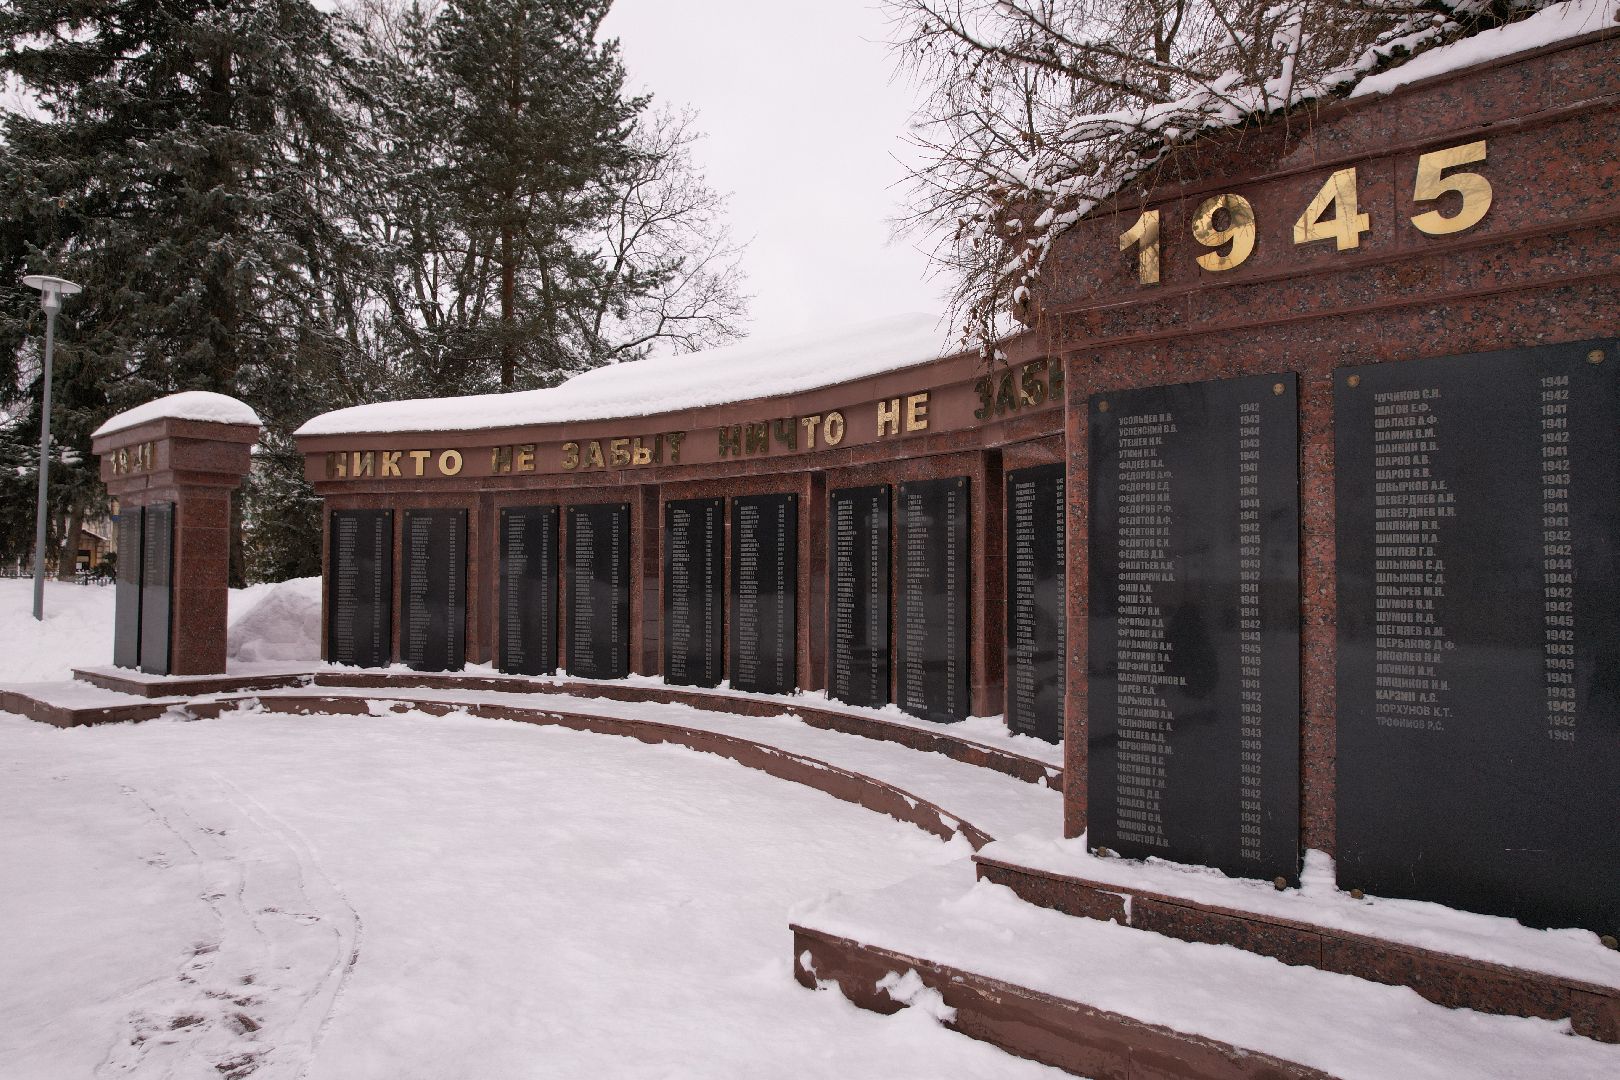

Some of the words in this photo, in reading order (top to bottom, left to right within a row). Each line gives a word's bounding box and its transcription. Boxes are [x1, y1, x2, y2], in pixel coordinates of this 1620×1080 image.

[1119, 140, 1493, 284] 1945
[1540, 376, 1568, 387] 1944
[1541, 390, 1568, 401] 1942
[1375, 405, 1408, 415] ШАГОВ
[1541, 404, 1567, 415] 1941
[1375, 417, 1415, 428] ШАЛАЕВ
[1541, 418, 1567, 429] 1941
[325, 449, 463, 478] НИКТО
[491, 444, 536, 473] НЕ
[561, 433, 686, 470] ЗАБЫТ
[718, 411, 844, 457] НИЧТО
[877, 393, 928, 437] НЕ
[1542, 432, 1569, 443] 1942
[1542, 446, 1568, 457] 1941
[1376, 456, 1410, 466] ШАРОВ
[1542, 460, 1570, 471] 1942
[1119, 471, 1155, 480] ФЕДОРОВ
[1376, 469, 1410, 479] ШАРОВ
[1542, 474, 1570, 485] 1943
[1119, 482, 1155, 491] ФЕДОРОВ
[1543, 489, 1568, 499] 1941
[1543, 503, 1569, 513] 1941
[1543, 517, 1569, 526] 1941
[1543, 531, 1571, 541] 1942
[1544, 545, 1571, 555] 1942
[1544, 559, 1572, 569] 1944
[1544, 574, 1572, 583] 1944
[1544, 588, 1572, 597] 1942
[1545, 602, 1572, 612] 1942
[1545, 616, 1573, 626] 1945
[1545, 630, 1573, 640] 1942
[1545, 644, 1573, 655] 1943
[1546, 658, 1574, 669] 1945
[1546, 672, 1572, 683] 1941
[1546, 687, 1574, 698] 1943
[1546, 701, 1574, 712] 1942
[1547, 715, 1575, 726] 1942
